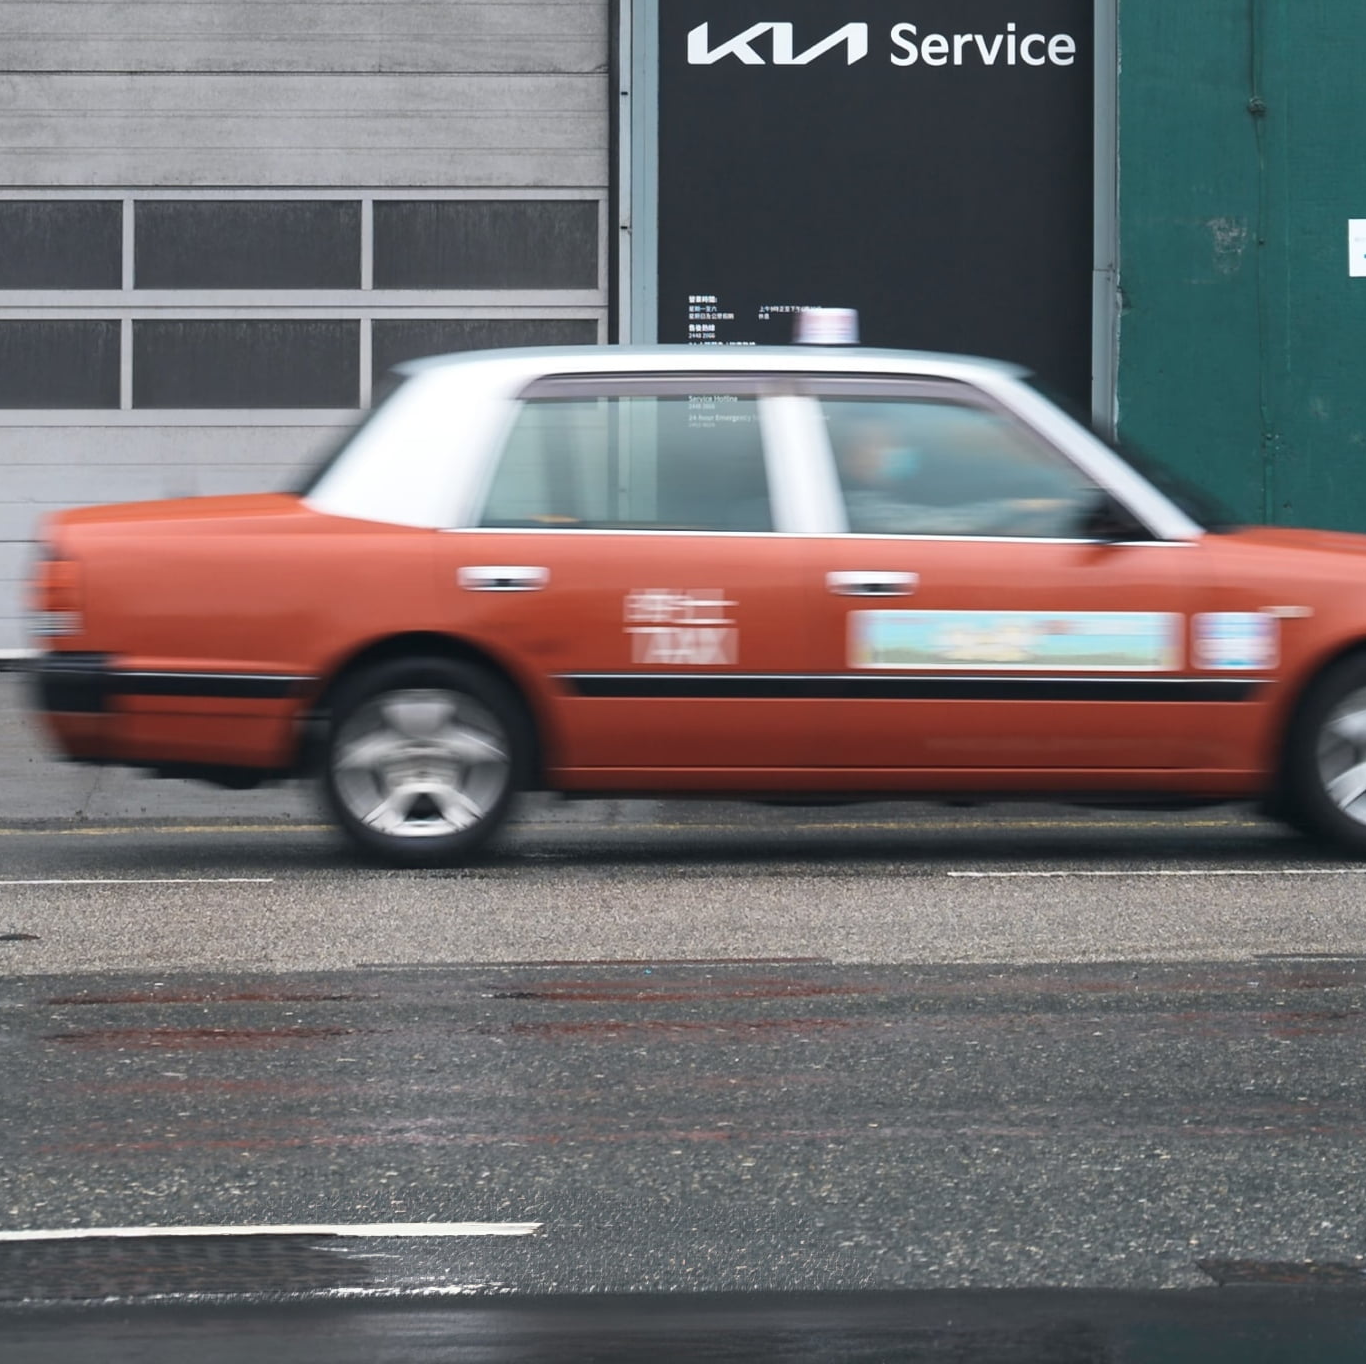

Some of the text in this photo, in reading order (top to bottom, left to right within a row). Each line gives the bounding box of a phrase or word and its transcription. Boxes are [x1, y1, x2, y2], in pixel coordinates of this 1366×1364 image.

[687, 21, 1077, 66] KIA Service
[688, 395, 713, 403] Service
